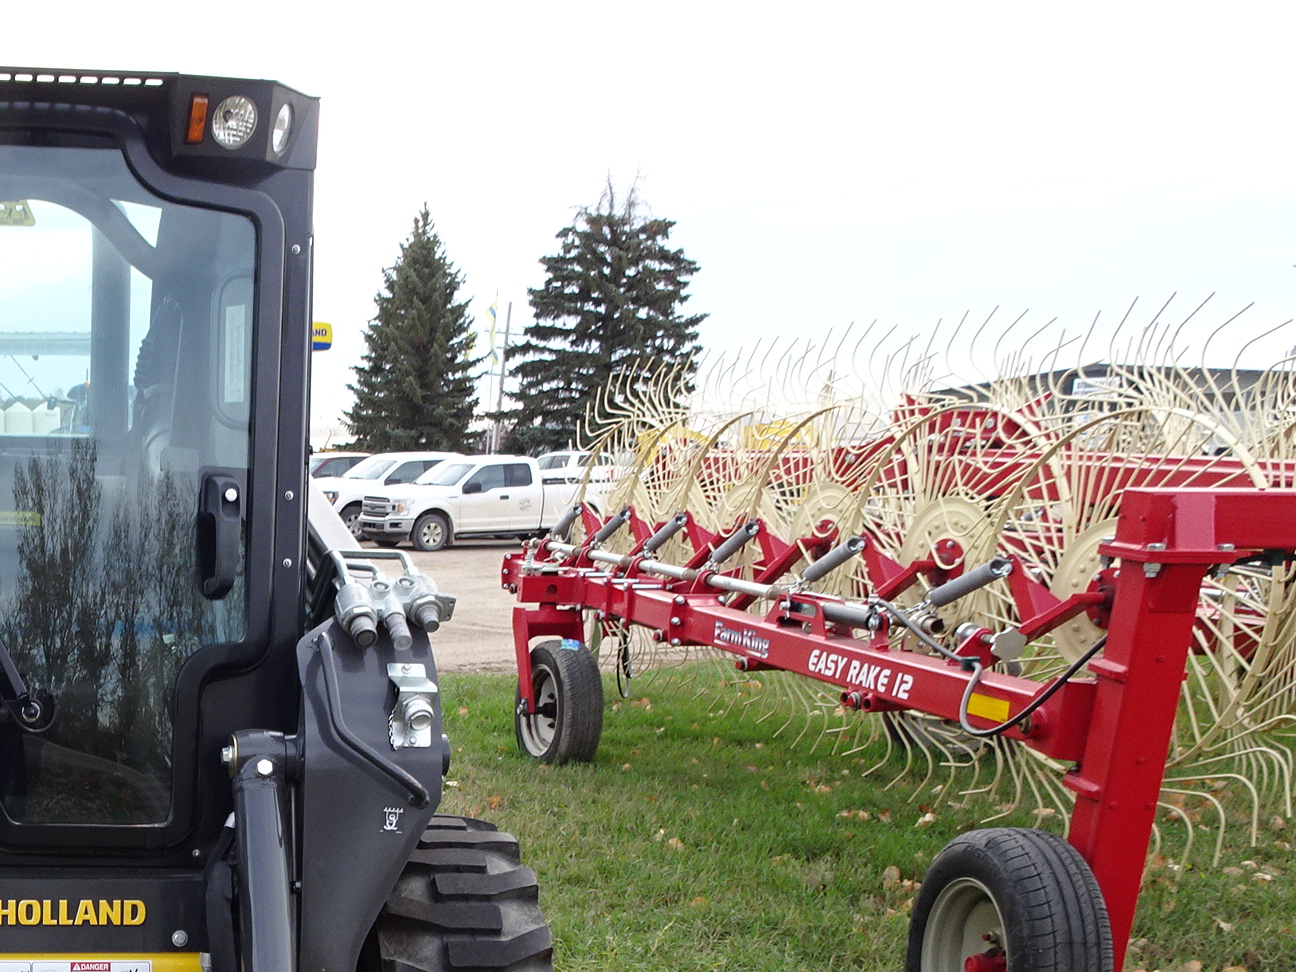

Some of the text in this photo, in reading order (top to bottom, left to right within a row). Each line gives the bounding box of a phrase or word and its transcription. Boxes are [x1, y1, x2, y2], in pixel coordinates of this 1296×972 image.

[807, 649, 914, 700] EASY RAKE 12
[80, 963, 109, 971] DANGER
